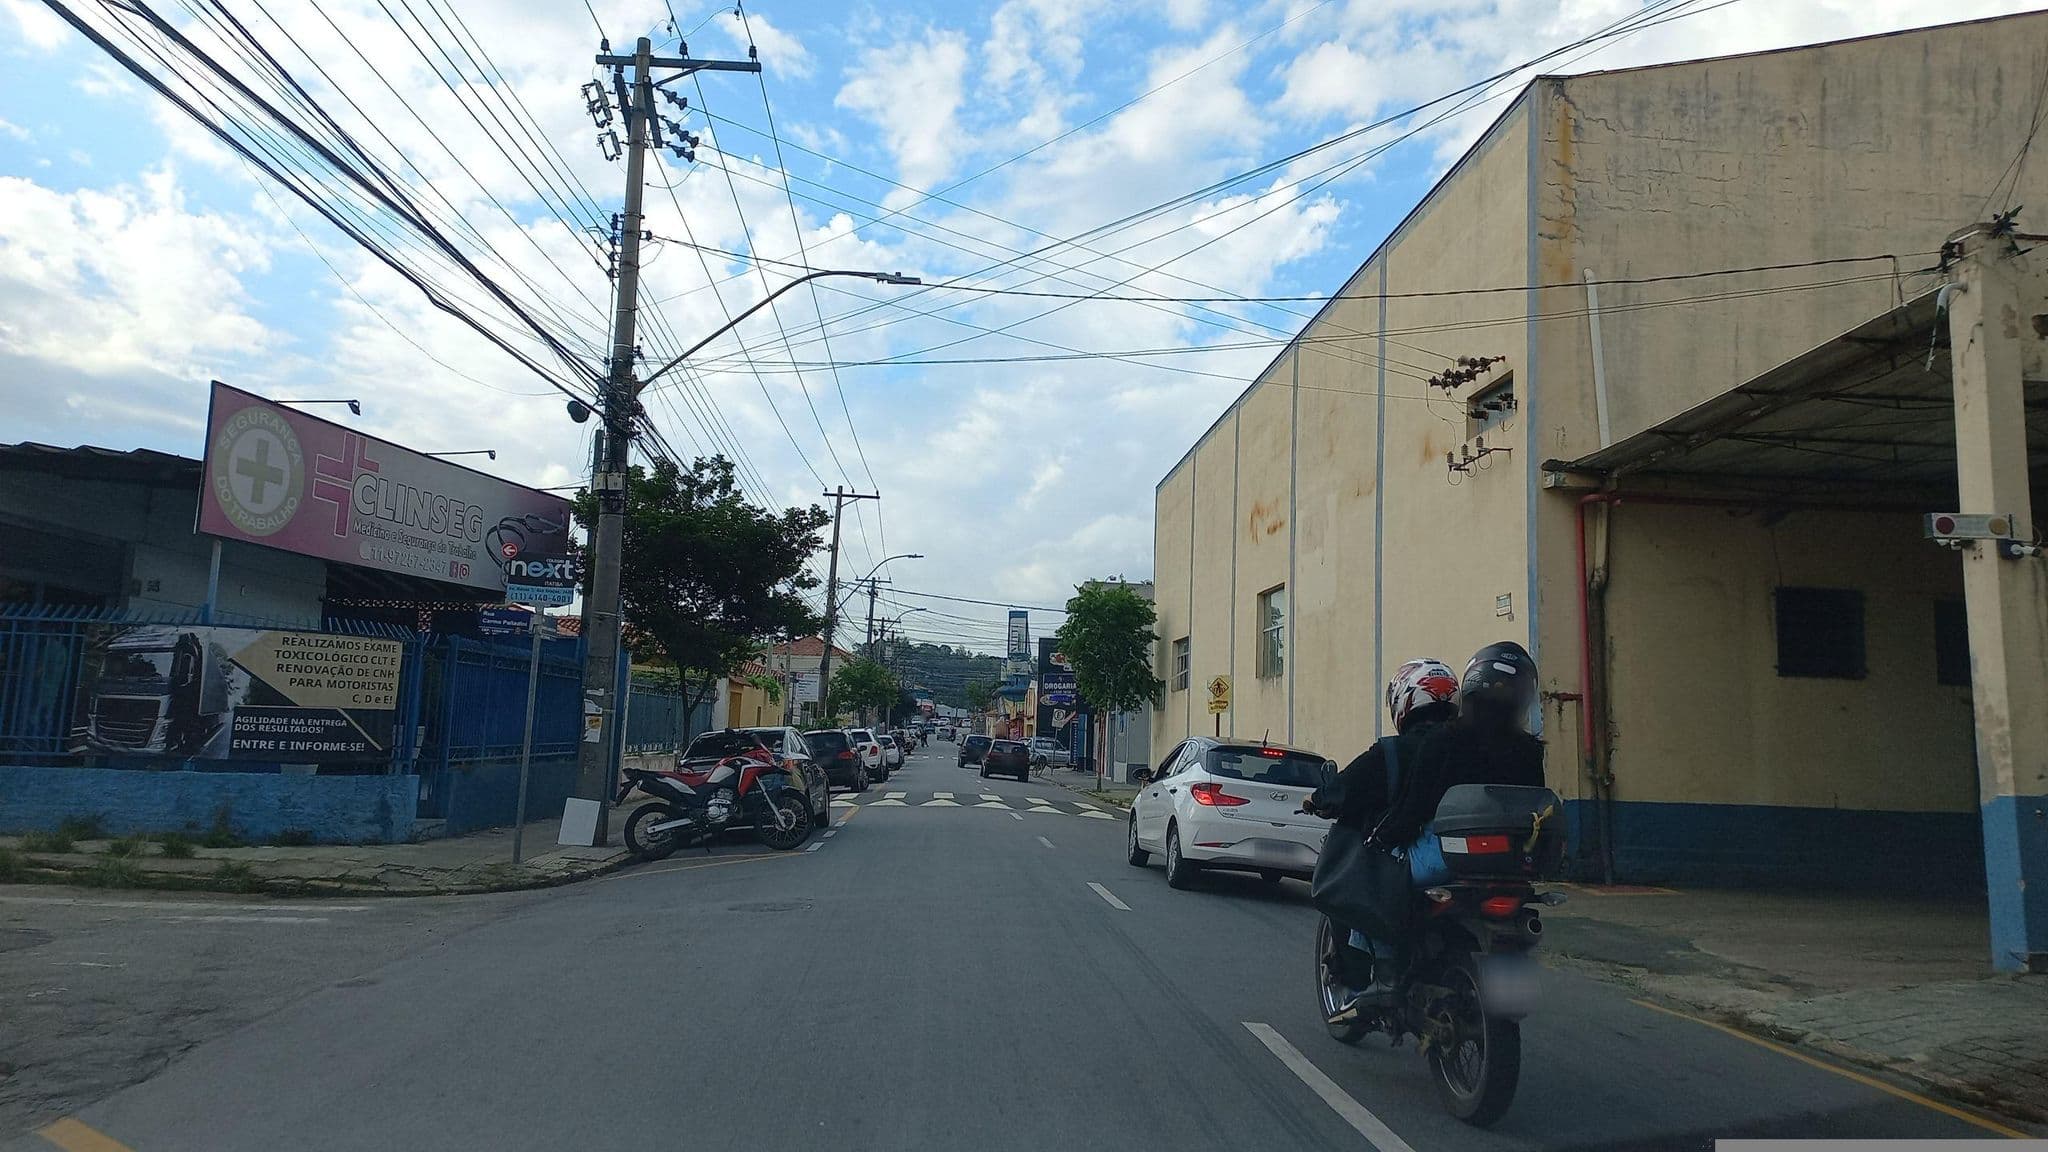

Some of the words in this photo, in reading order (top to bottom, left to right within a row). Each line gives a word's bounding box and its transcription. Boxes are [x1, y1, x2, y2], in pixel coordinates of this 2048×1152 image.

[353, 473, 483, 543] CLINSEG
[352, 519, 391, 541] Medicina
[511, 559, 574, 580] next
[282, 636, 361, 651] REALIZAMOS
[364, 642, 397, 654] EXAME
[274, 649, 369, 664] TOXICOLÓGICO
[370, 656, 388, 666] CLT
[390, 657, 396, 666] E
[276, 663, 354, 678] RENOVAÇÃO
[357, 668, 370, 677] DE
[373, 669, 395, 679] CNH
[289, 677, 322, 688] PARA
[326, 679, 394, 692] MOTORISTAS
[352, 694, 361, 704] C,
[365, 695, 372, 703] D
[374, 696, 381, 704] e
[384, 695, 393, 704] E!
[234, 723, 256, 732] DOS
[259, 724, 325, 734] RESULTADOS!
[235, 716, 289, 725] AGILIDADE
[291, 717, 305, 725] NA
[307, 718, 348, 727] ENTREGA
[233, 739, 276, 750] ENTRE
[279, 740, 287, 750] E
[290, 740, 366, 752] INFORME-SE!
